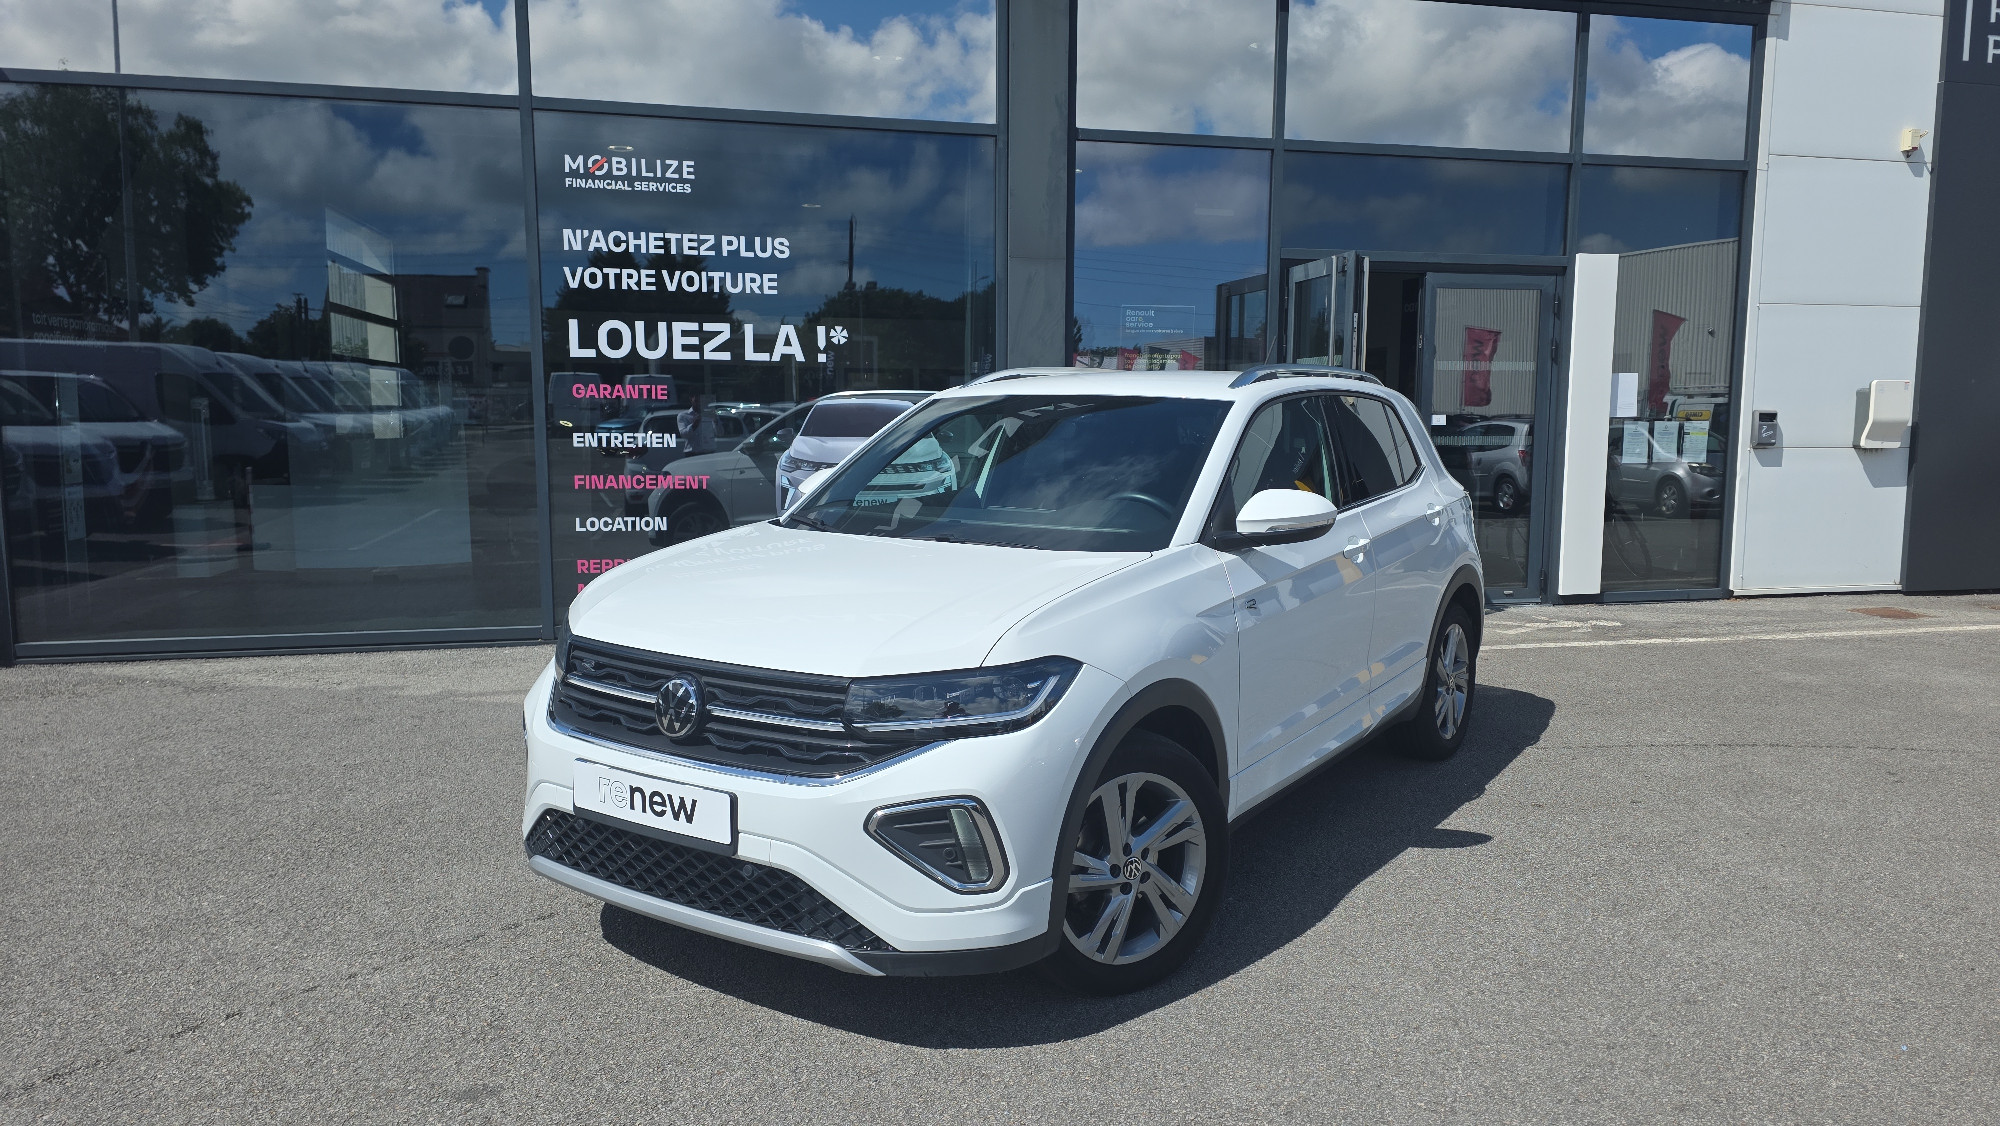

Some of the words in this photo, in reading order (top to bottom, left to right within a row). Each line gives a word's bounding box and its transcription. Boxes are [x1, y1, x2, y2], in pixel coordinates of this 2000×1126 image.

[565, 178, 632, 191] FINANCIAL
[634, 182, 691, 193] SERVICES
[721, 235, 790, 259] PLUS
[563, 267, 656, 291] VOTRE
[661, 270, 778, 295] VOITURE
[568, 319, 731, 362] LOUEZ
[744, 324, 805, 363] LA
[572, 384, 668, 400] GARANTIE
[572, 432, 676, 448] ENTRETIEN
[574, 475, 710, 489] FINANCEMENT
[575, 516, 668, 532] LOCATION
[577, 558, 631, 574] REP
[598, 775, 698, 825] renew
